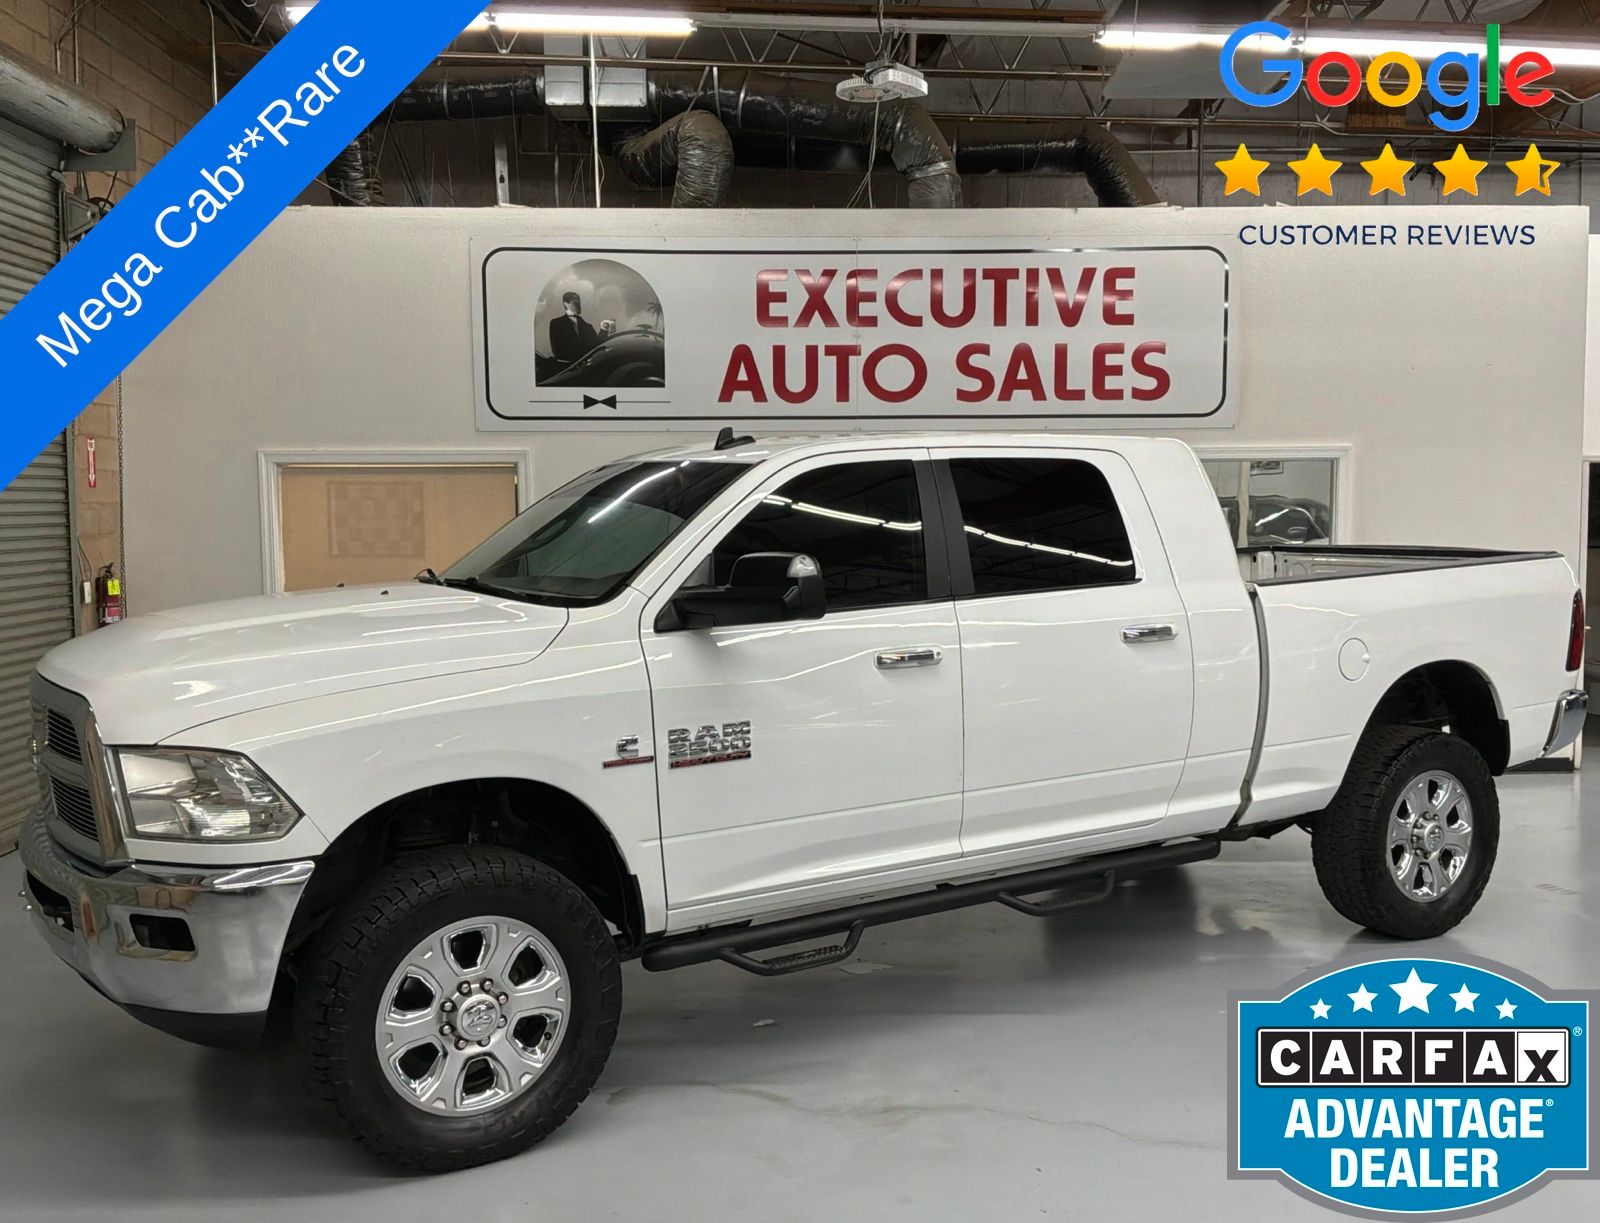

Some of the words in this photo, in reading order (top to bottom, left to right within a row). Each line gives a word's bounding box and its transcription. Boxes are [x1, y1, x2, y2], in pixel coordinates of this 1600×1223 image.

[755, 266, 1137, 328] EXECUTIVE
[716, 343, 928, 404] AUTO
[955, 340, 1171, 402] SALES
[667, 720, 751, 745] RAM
